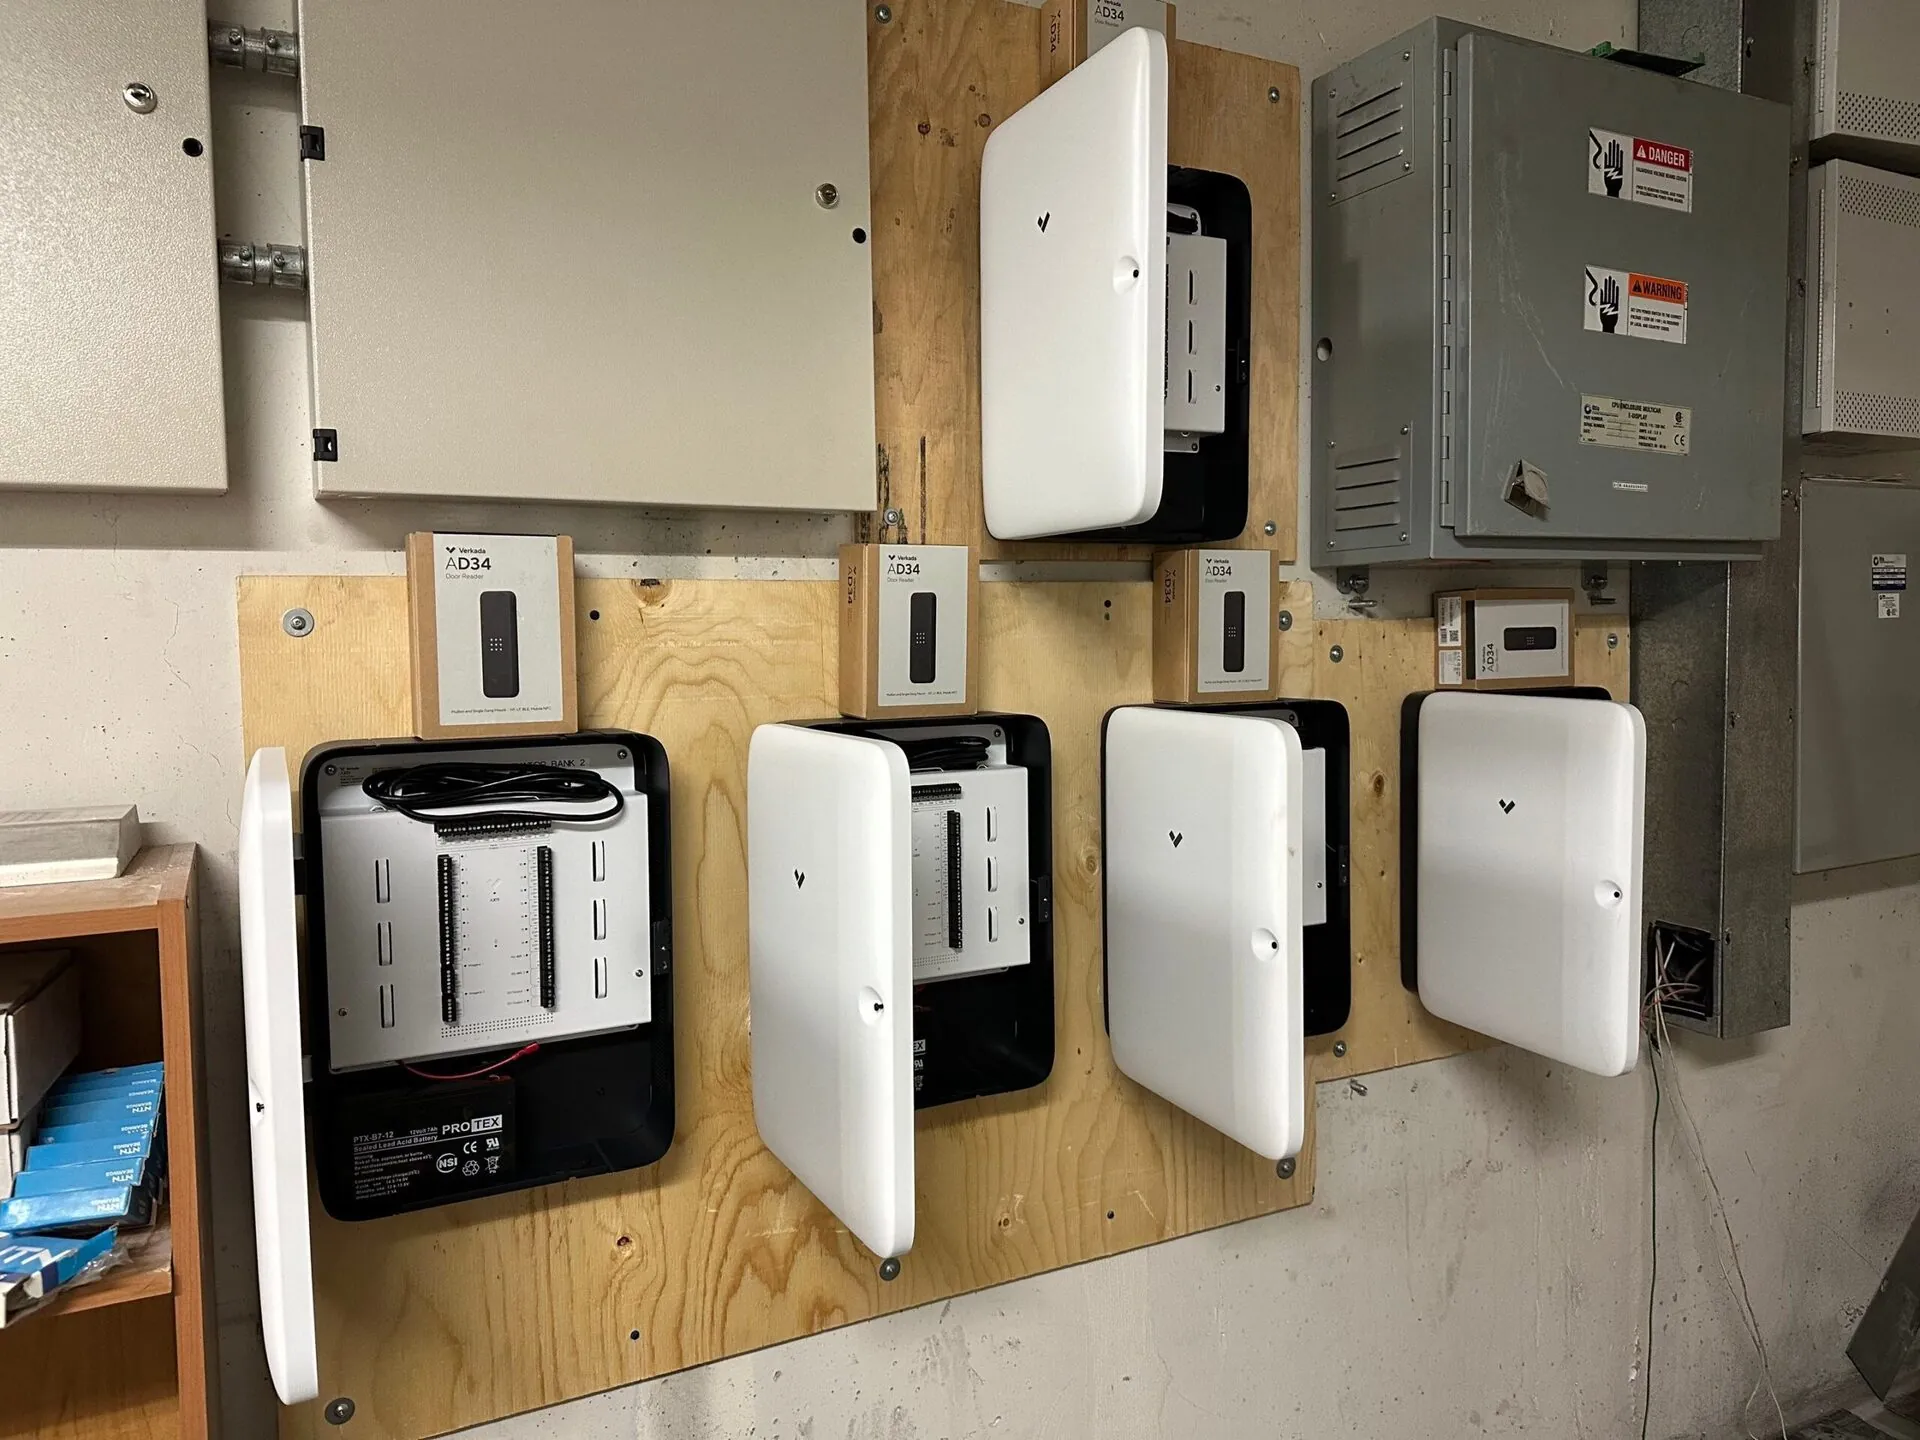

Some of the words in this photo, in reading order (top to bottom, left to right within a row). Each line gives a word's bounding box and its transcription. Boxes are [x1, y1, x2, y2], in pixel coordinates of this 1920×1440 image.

[1095, 5, 1124, 21] AD34
[1649, 146, 1685, 167] DANGER
[1642, 280, 1682, 300] WARNING
[445, 557, 491, 570] AD34
[887, 563, 920, 574] AD34
[1205, 566, 1232, 576] AD34
[580, 758, 586, 766] 2
[442, 1115, 501, 1135] PROTEX
[353, 1131, 394, 1144] PTX-B7-12
[353, 1141, 378, 1152] Sealed
[379, 1139, 396, 1149] Lead
[397, 1137, 413, 1147] Acid
[413, 1134, 439, 1145] Battery
[120, 1146, 141, 1155] NTN
[463, 1141, 477, 1154] CE
[438, 1157, 458, 1169] NSI
[112, 1174, 133, 1183] NTN
